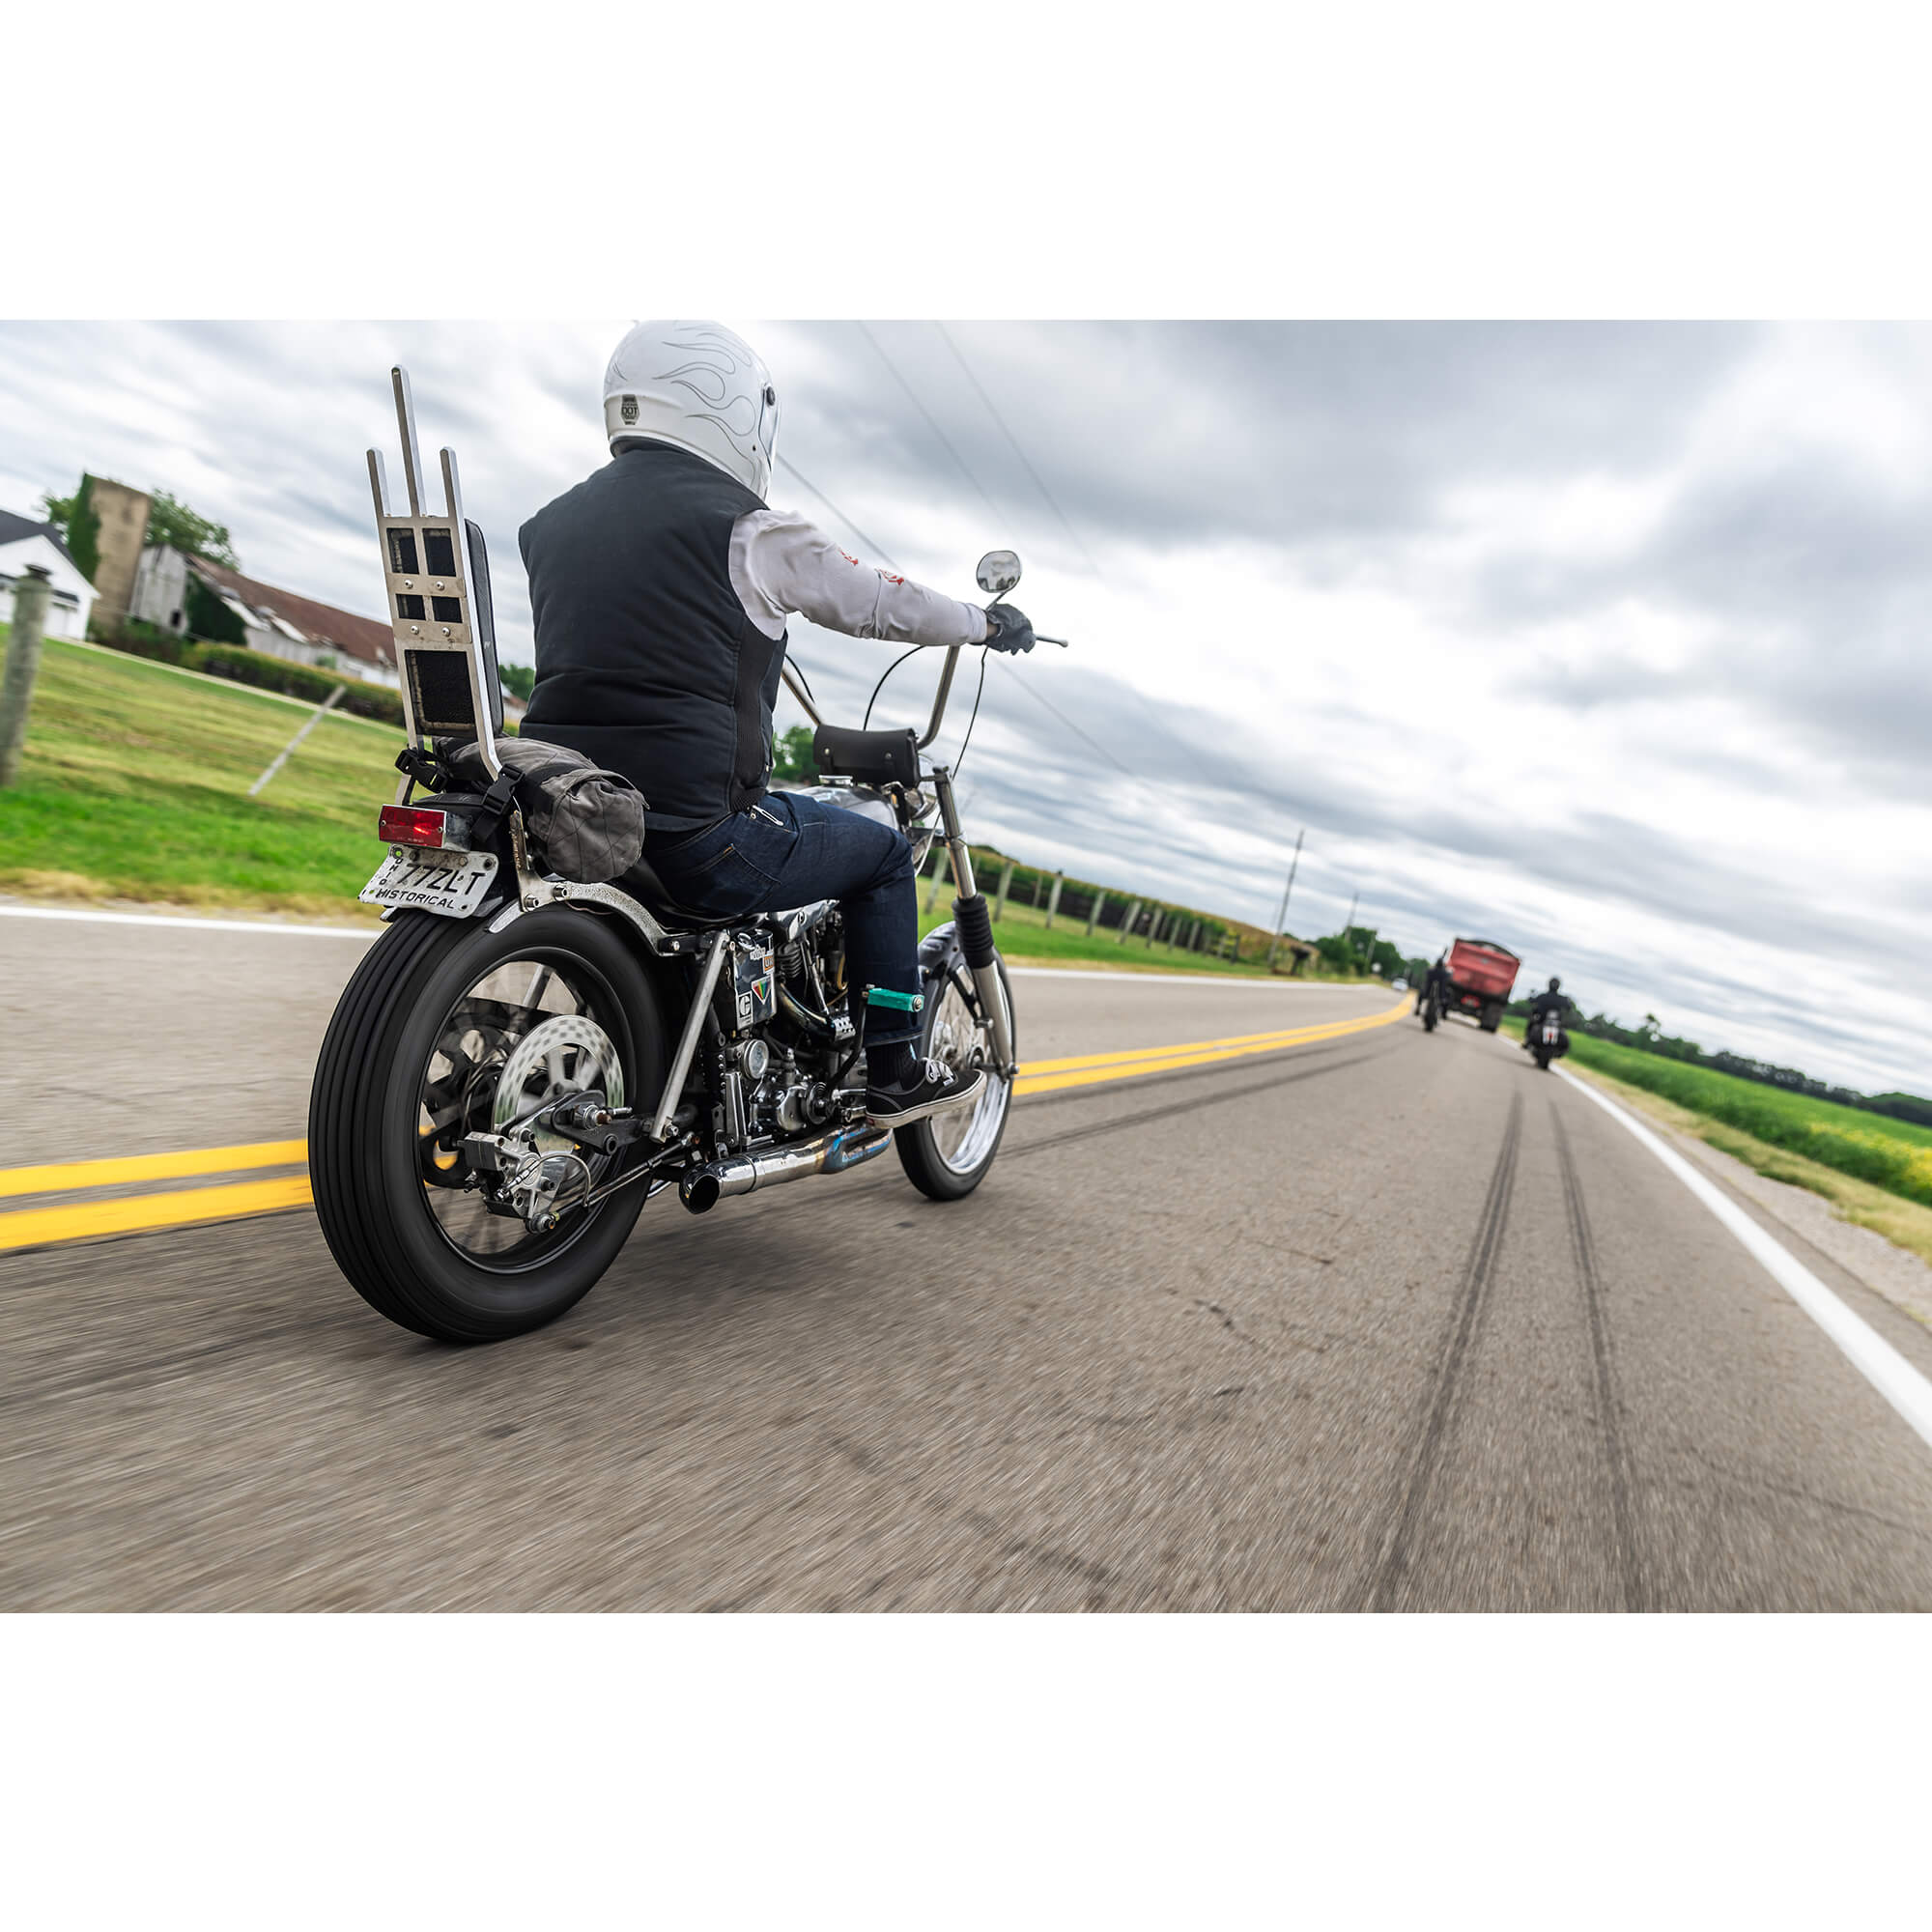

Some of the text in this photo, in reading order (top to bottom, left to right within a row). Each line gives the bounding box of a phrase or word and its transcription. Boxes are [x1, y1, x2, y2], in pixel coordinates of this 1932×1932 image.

[621, 407, 638, 416] DOT
[379, 858, 403, 885] OHIO
[397, 863, 486, 895] 77ZLT
[375, 888, 455, 909] HISTORICAL
